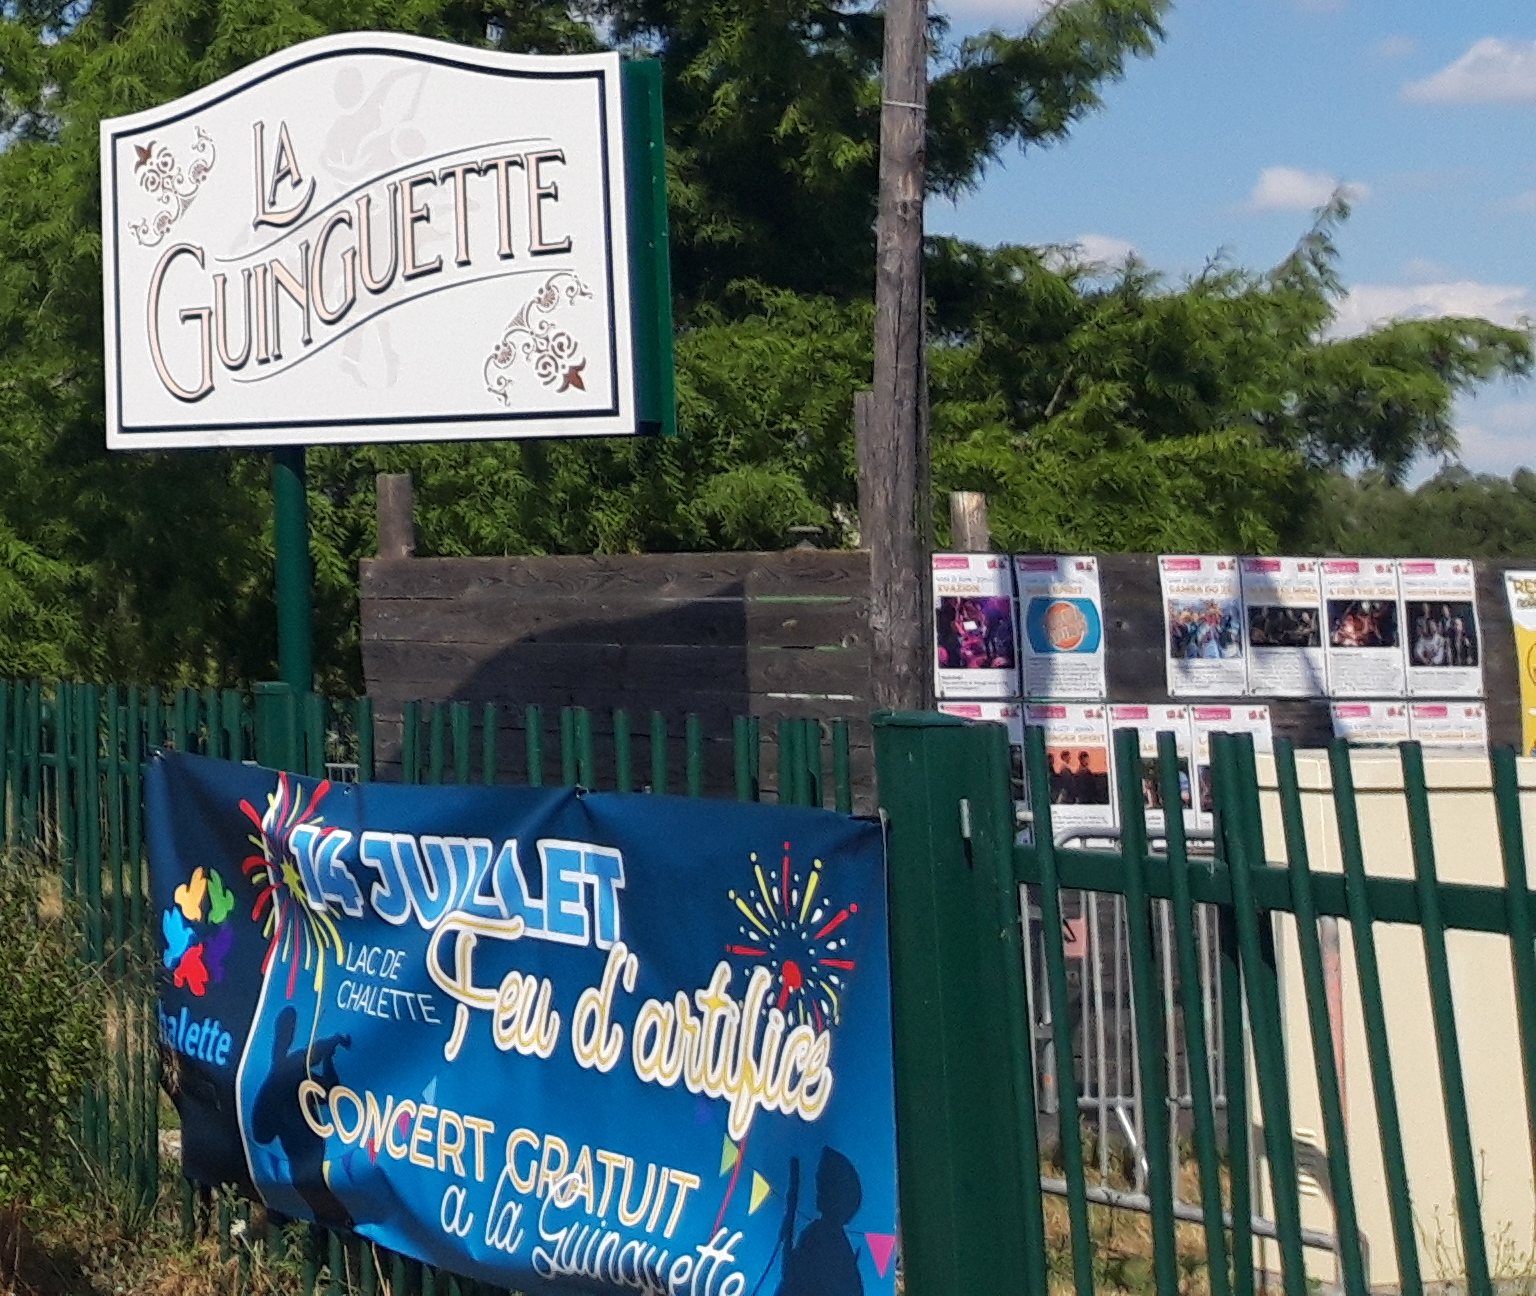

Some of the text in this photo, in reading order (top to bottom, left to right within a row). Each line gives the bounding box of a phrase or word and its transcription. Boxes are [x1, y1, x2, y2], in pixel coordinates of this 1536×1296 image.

[251, 120, 316, 230] LA
[146, 148, 573, 404] GUINGUETTE
[360, 831, 626, 951] JUILLET
[336, 979, 442, 1025] CHALETTE
[345, 941, 406, 981] LAC DE
[426, 910, 560, 1062] Feu
[298, 1079, 701, 1238] CONCERT GRATUIT
[484, 1164, 526, 1254] la
